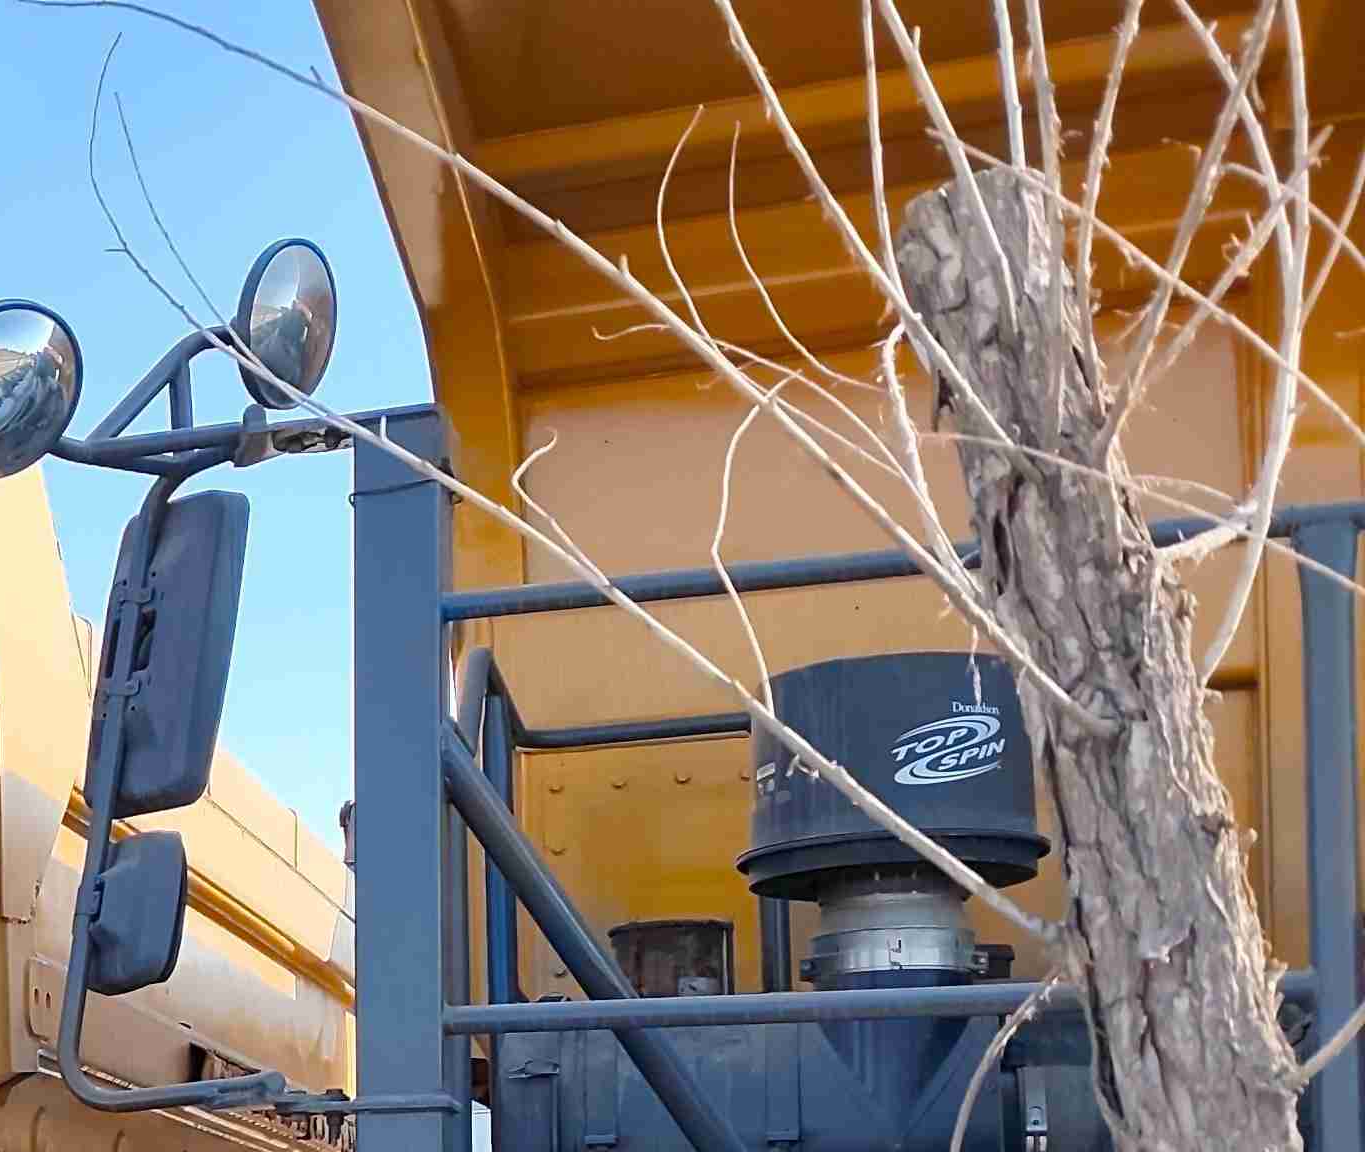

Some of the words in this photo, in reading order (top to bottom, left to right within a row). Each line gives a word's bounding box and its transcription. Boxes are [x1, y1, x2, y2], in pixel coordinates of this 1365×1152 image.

[952, 702, 1000, 714] Donaldson
[892, 728, 969, 760] TOP
[939, 738, 1006, 771] SPIN
